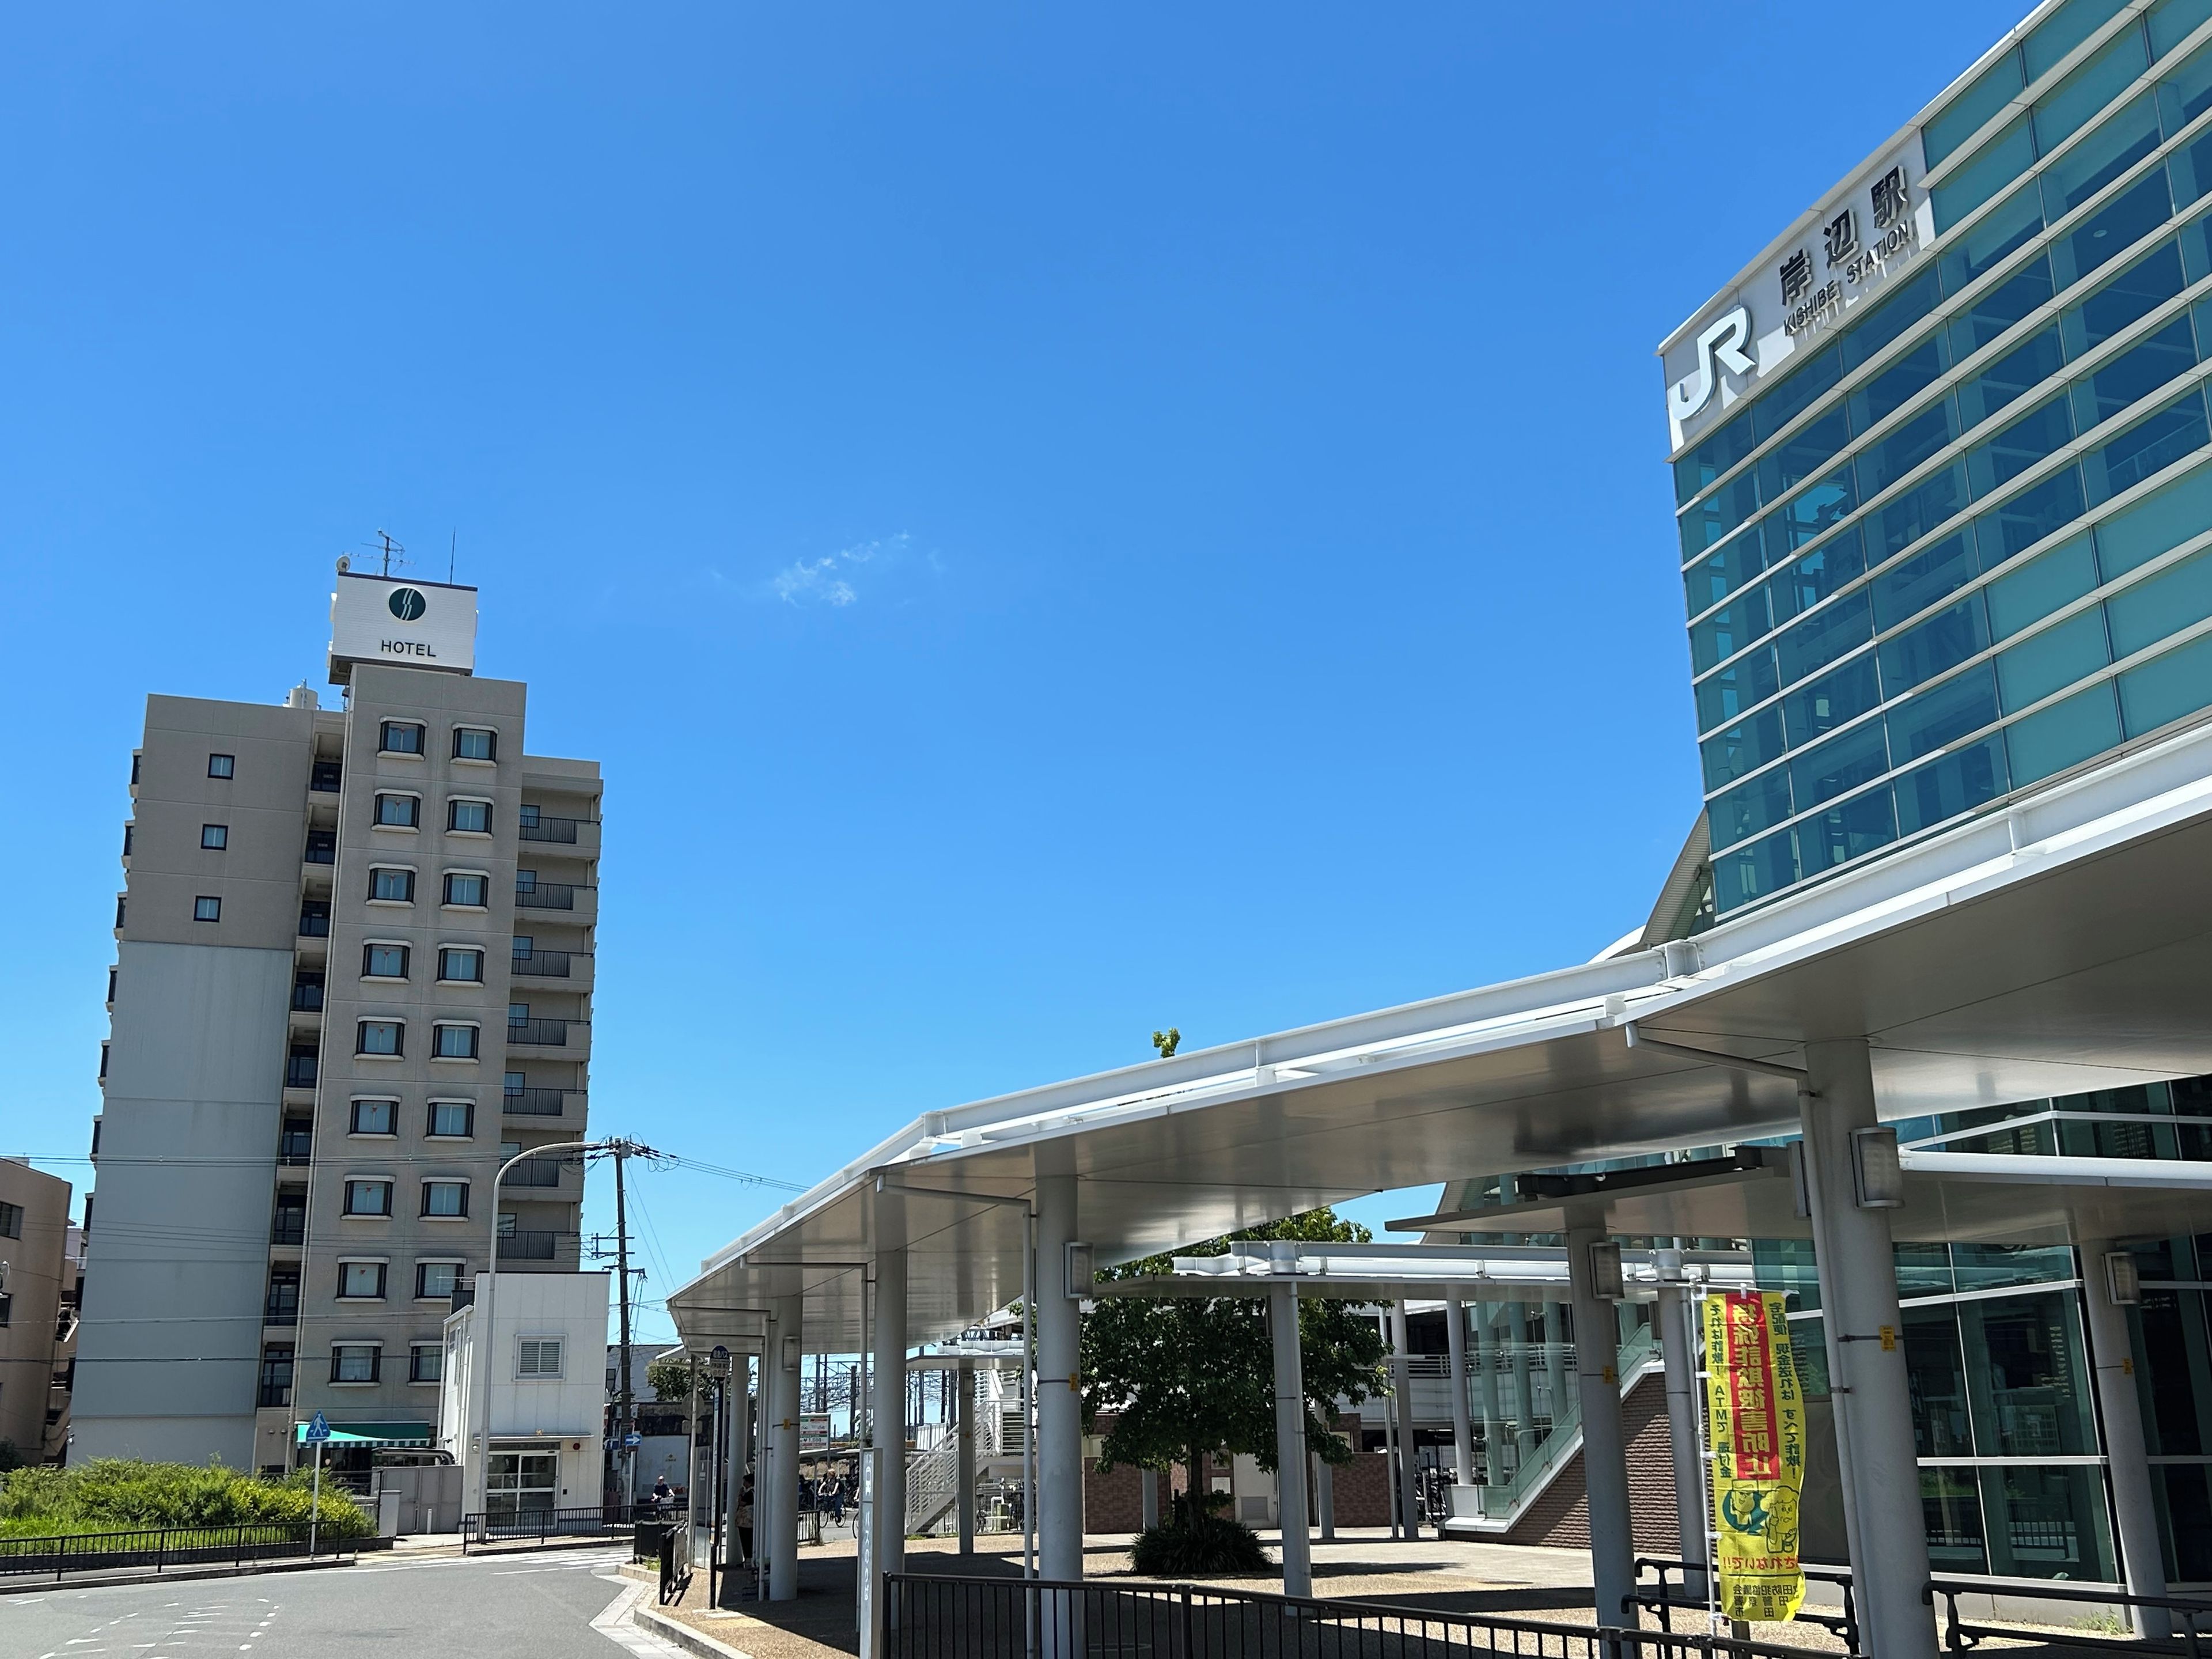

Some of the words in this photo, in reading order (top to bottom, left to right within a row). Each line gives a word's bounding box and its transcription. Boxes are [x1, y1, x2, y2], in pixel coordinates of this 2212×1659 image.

[1780, 165, 1907, 306] 岸辺駅
[1783, 279, 1841, 336] KISHIBE
[1846, 219, 1913, 285] STATION
[1672, 305, 1755, 420] JR
[381, 639, 436, 657] HOTEL
